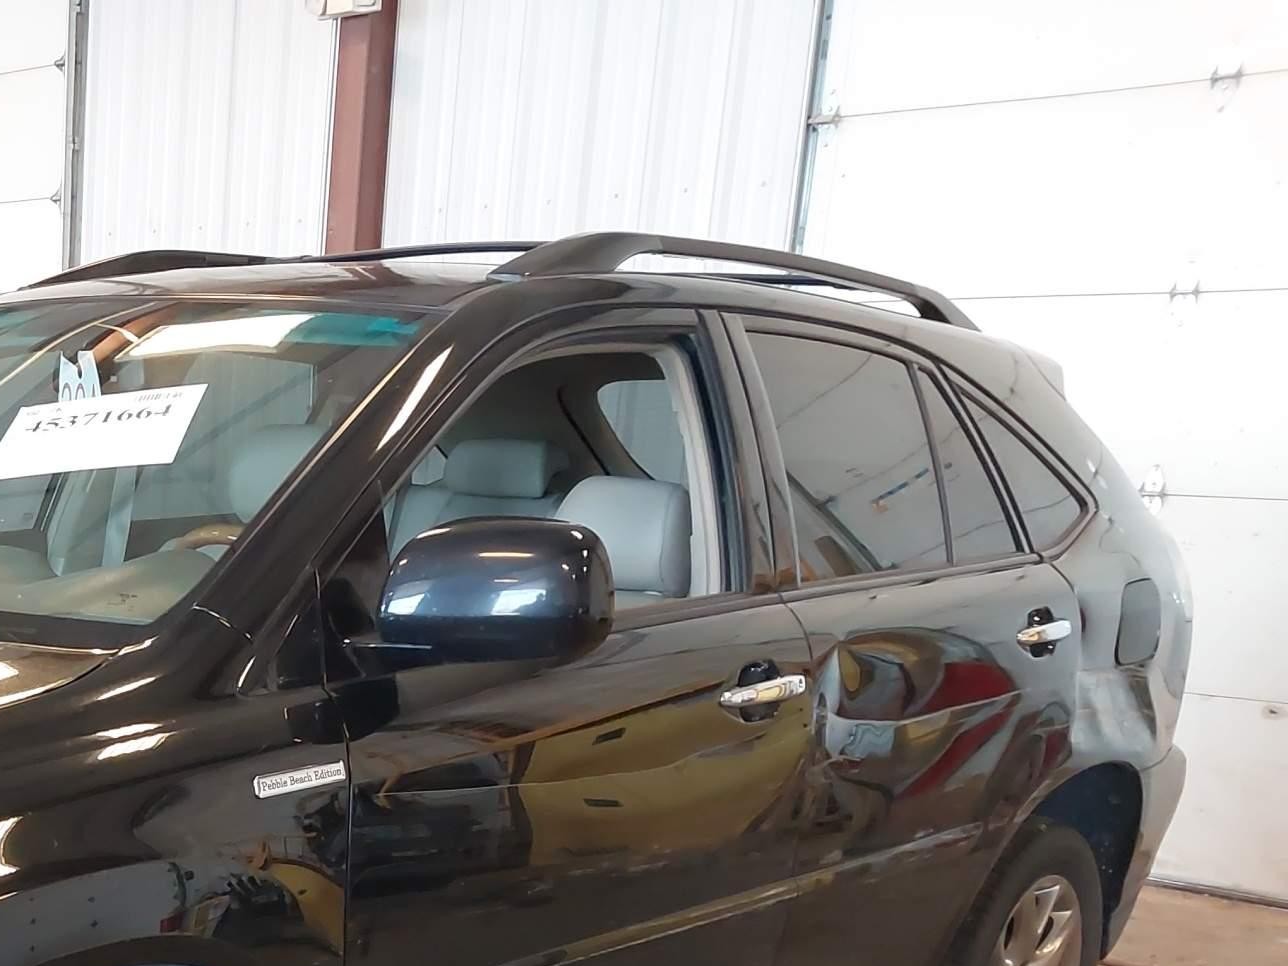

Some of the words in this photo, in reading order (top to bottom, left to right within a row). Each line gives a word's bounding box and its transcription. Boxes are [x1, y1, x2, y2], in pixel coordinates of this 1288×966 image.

[25, 404, 172, 432] 45371664
[261, 779, 288, 791] Pebble
[289, 772, 312, 785] Beach
[314, 768, 342, 780] Edition
